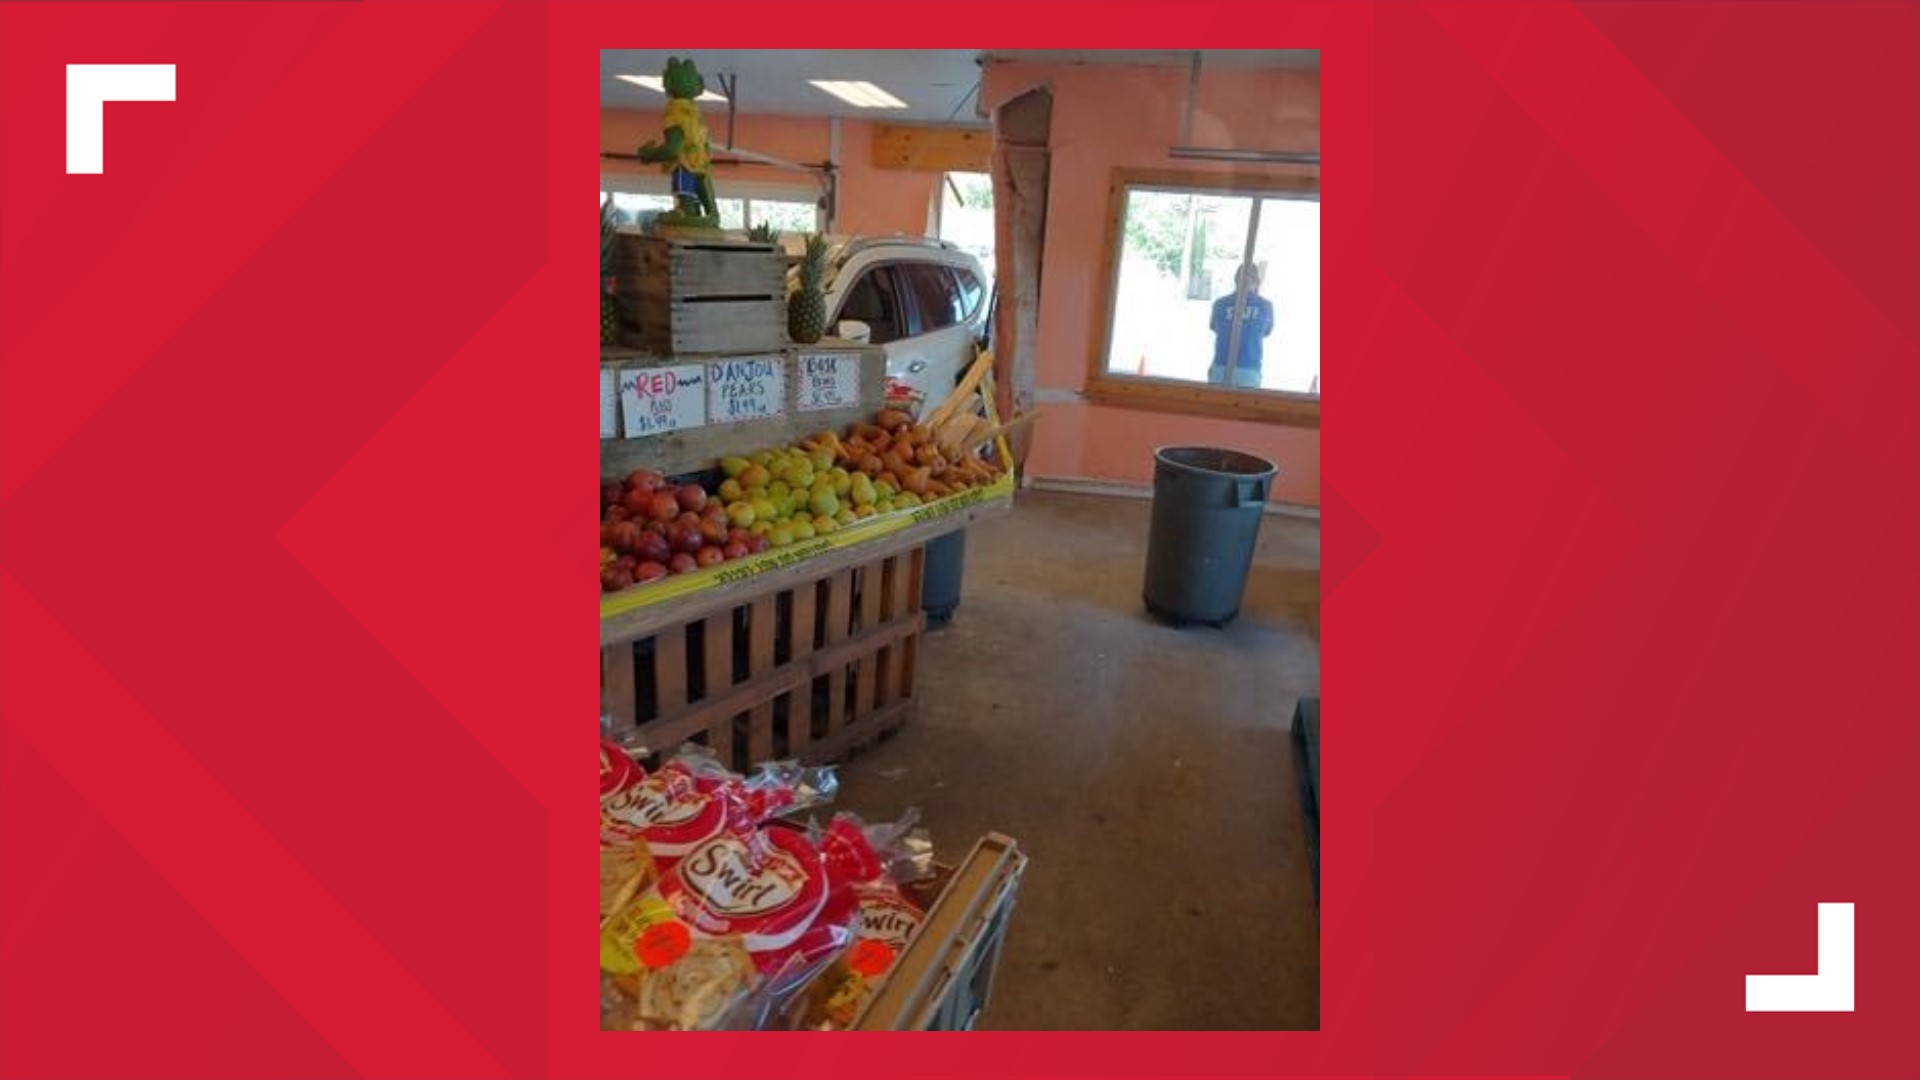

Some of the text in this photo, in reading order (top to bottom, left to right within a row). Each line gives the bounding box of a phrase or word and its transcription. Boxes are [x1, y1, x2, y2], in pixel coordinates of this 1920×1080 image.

[635, 371, 676, 399] RED
[690, 844, 776, 906] Swirl
[861, 909, 916, 938] wirl
